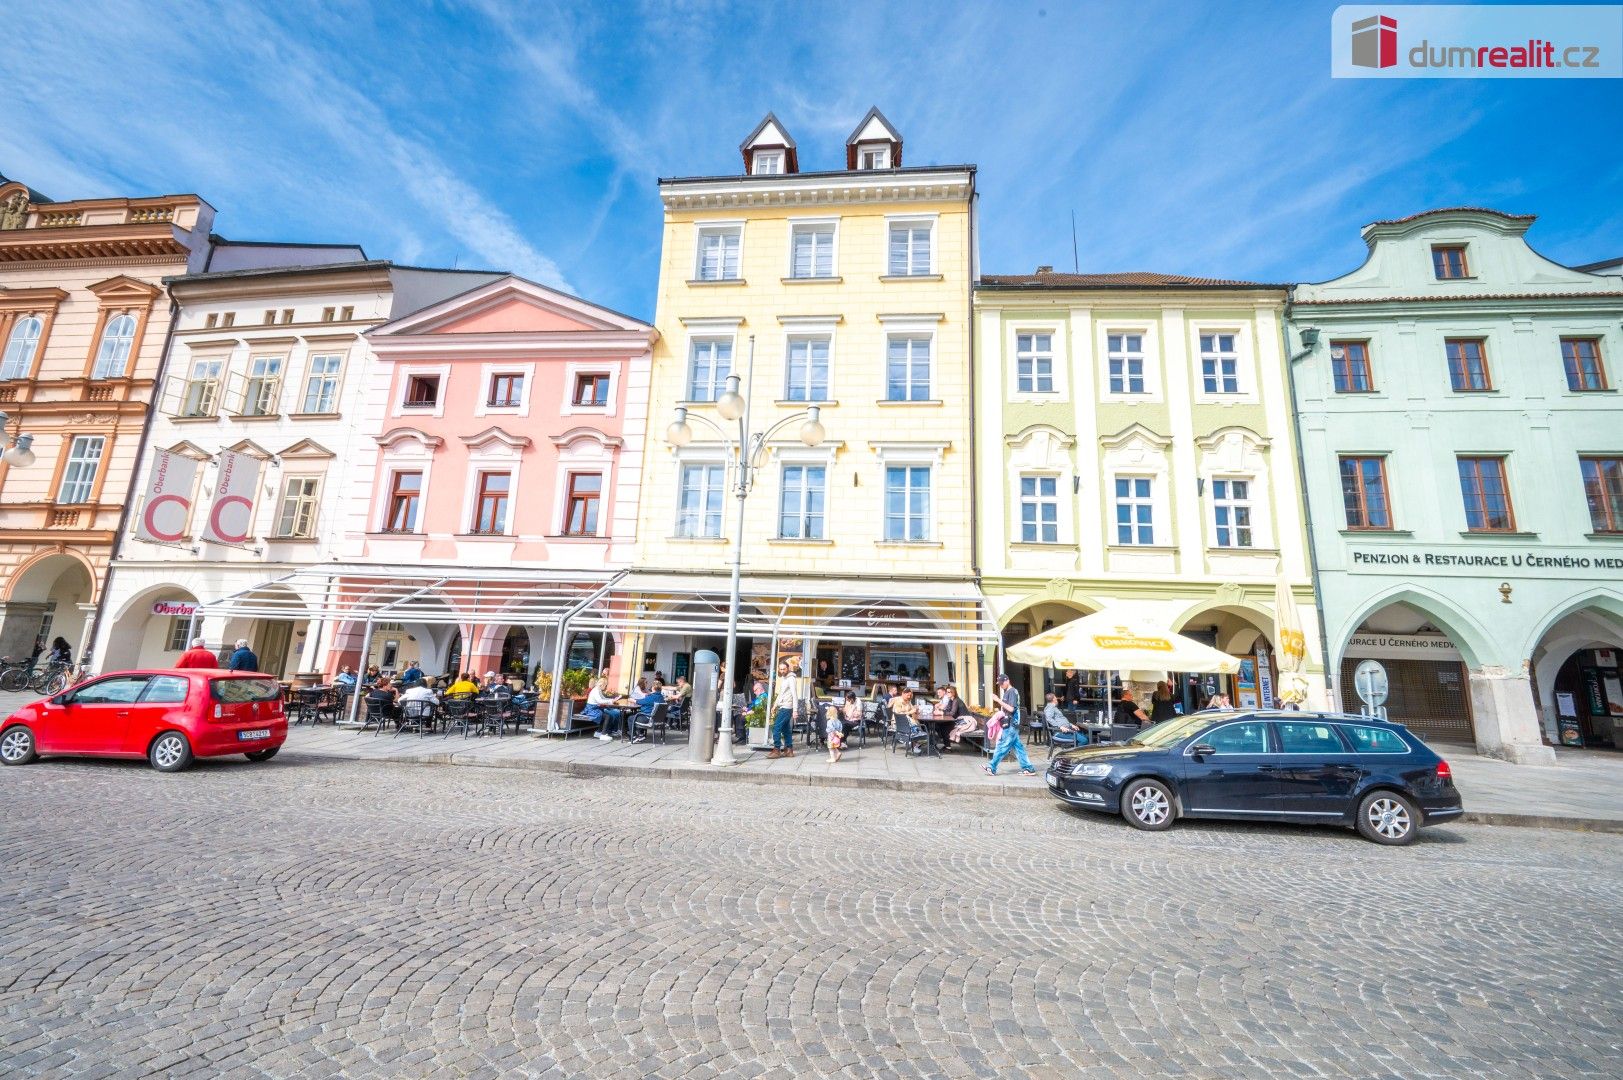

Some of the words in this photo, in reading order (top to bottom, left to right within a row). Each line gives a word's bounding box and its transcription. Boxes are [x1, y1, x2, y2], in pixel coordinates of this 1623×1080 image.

[153, 453, 170, 494] Oberbank
[219, 453, 236, 494] Oberbank
[1412, 555, 1421, 564] &
[1512, 555, 1522, 567] U
[1595, 558, 1623, 569] MED
[154, 602, 199, 615] Oberba
[1379, 638, 1386, 647] U
[1261, 677, 1271, 702] INTERNET
